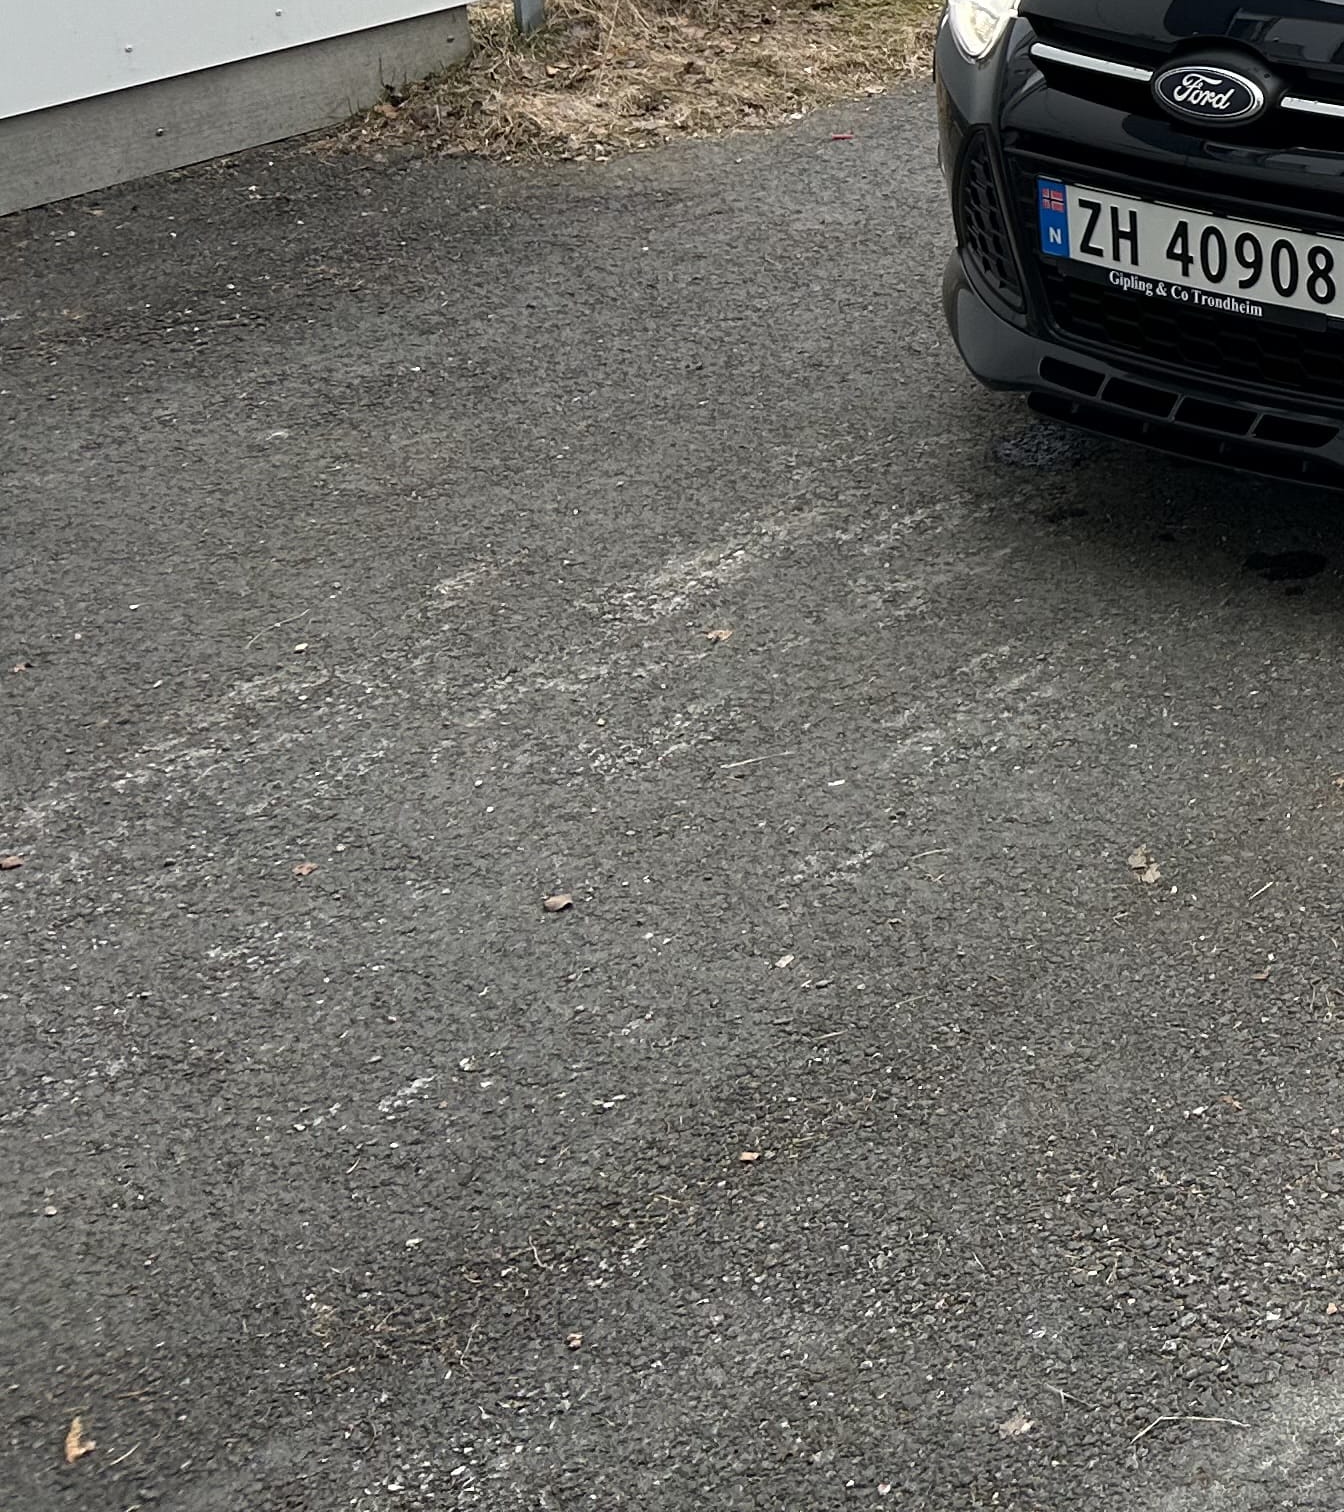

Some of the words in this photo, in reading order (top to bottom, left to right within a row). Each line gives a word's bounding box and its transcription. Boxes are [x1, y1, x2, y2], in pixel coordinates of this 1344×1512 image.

[1173, 73, 1236, 110] Ford
[1049, 227, 1063, 245] N
[1078, 199, 1140, 266] ZH
[1166, 220, 1337, 305] 40908
[1109, 270, 1154, 297] Gipling
[1156, 282, 1168, 297] &
[1170, 285, 1189, 301] Co
[1191, 290, 1264, 317] Trondheim
